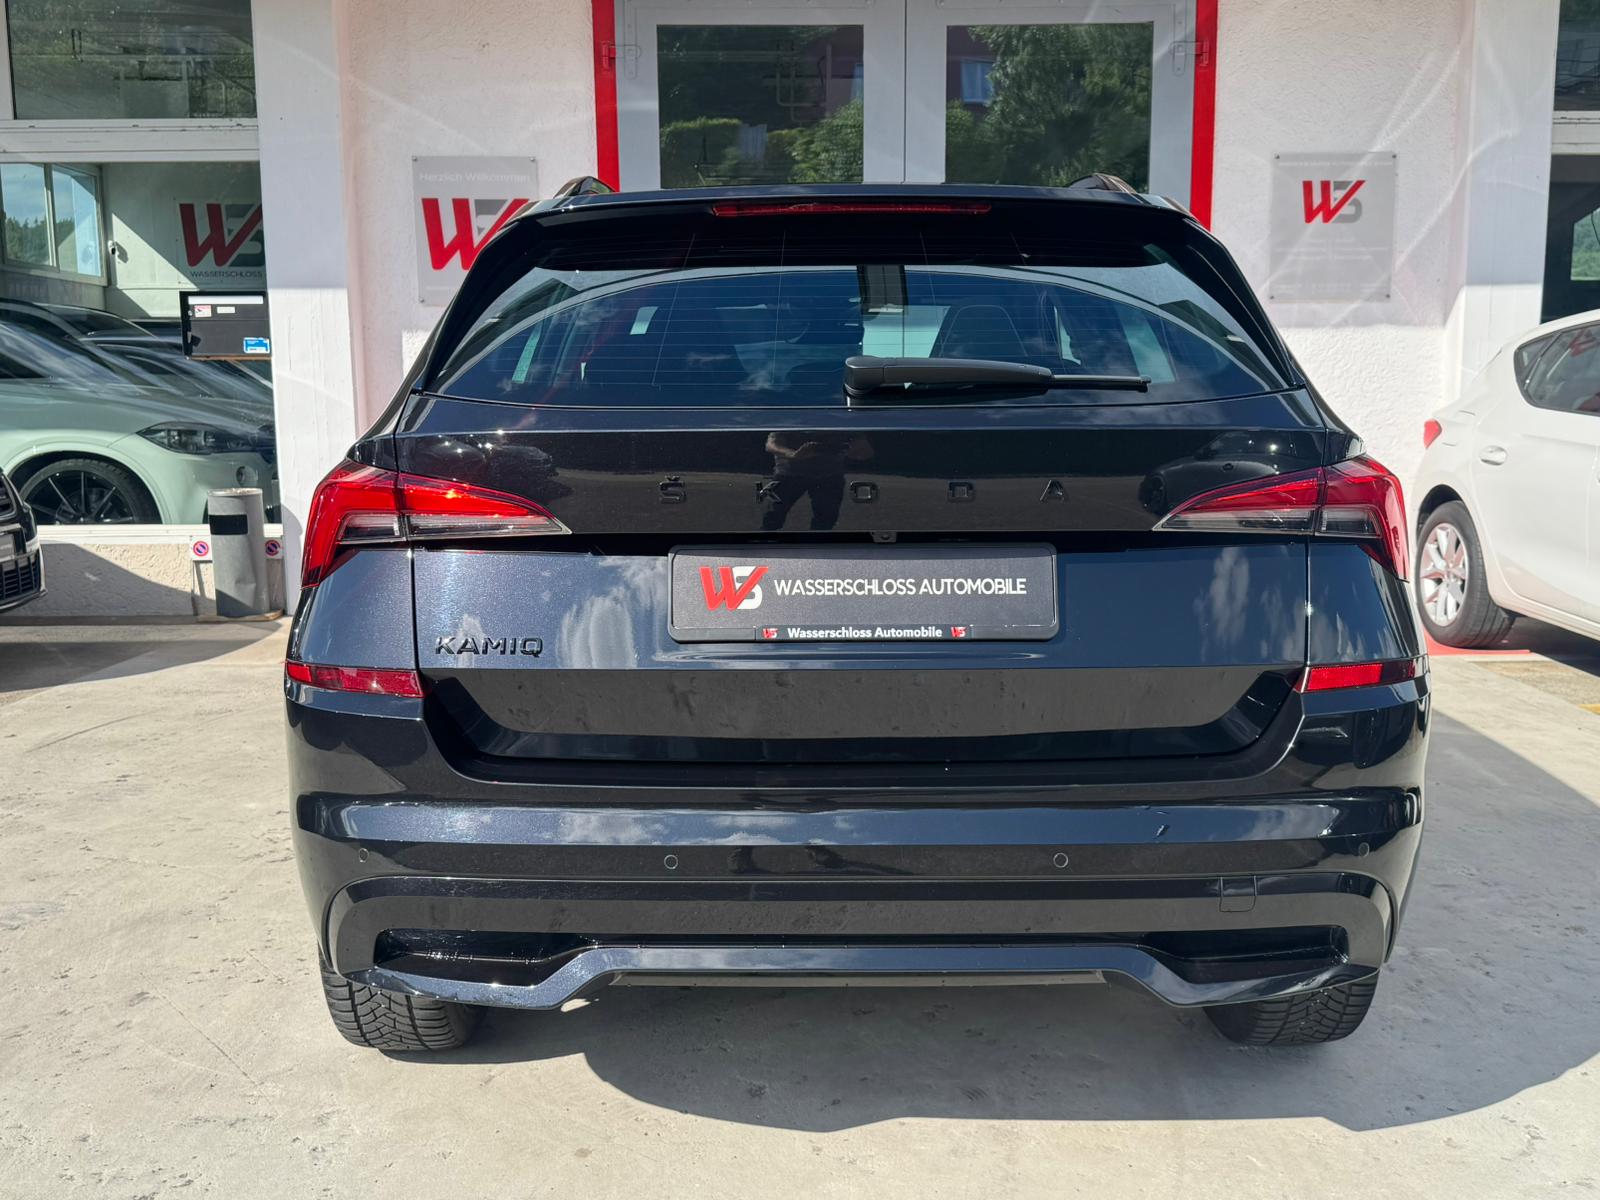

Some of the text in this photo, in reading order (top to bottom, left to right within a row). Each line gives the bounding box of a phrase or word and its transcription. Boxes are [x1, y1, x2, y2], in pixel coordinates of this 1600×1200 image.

[419, 172, 531, 182] Herzlich Willkommen
[190, 270, 263, 278] WASSERSCHLOSS
[773, 579, 916, 596] WASSERSCHLOSS
[918, 577, 1027, 595] AUTOMOBILE
[787, 626, 872, 639] Wasserschloss
[874, 625, 943, 638] Automobile
[435, 636, 544, 658] KAMIQ
